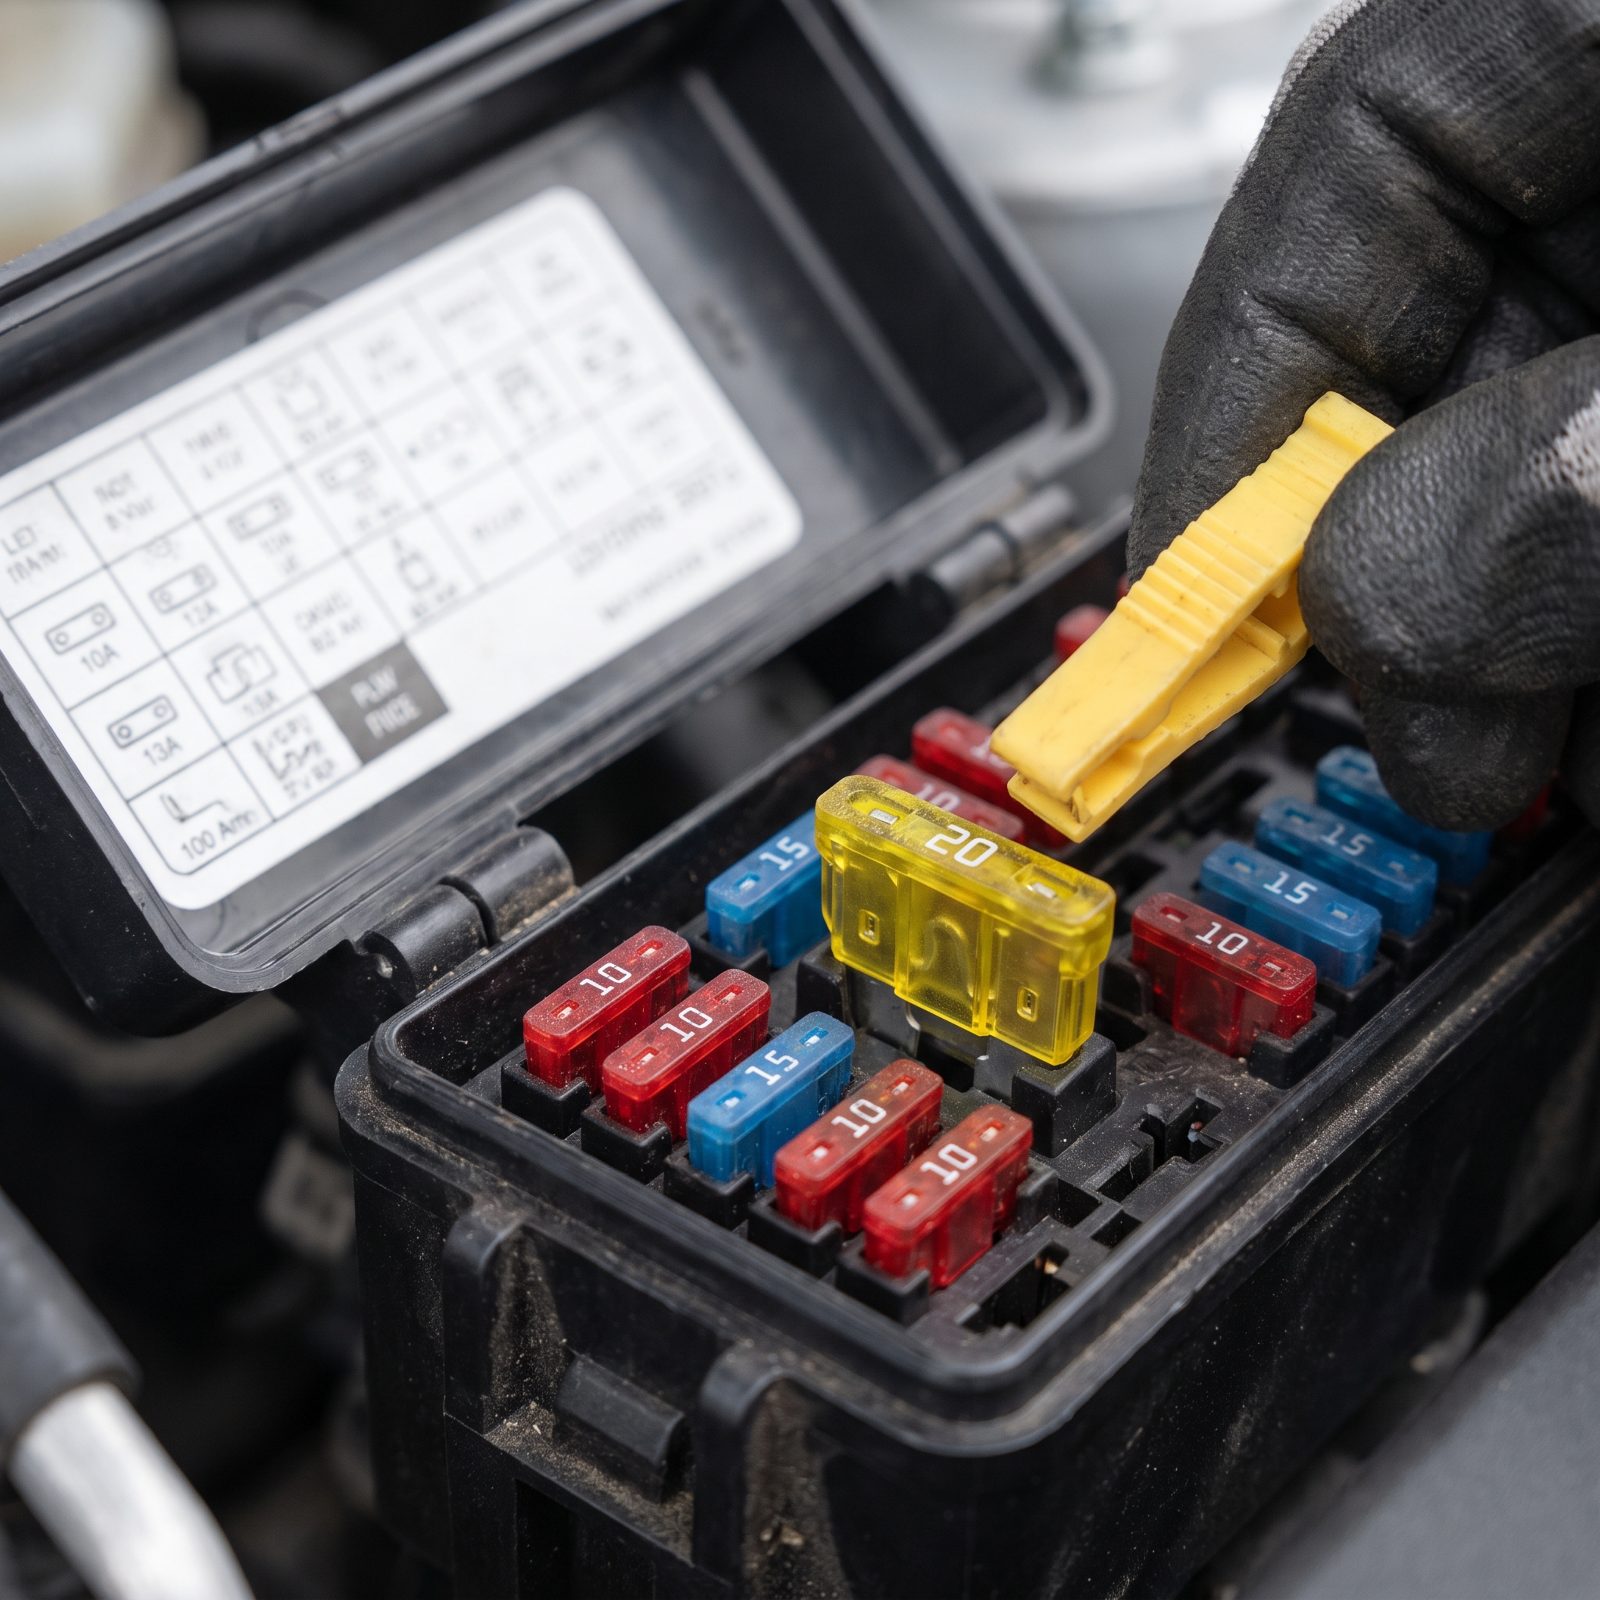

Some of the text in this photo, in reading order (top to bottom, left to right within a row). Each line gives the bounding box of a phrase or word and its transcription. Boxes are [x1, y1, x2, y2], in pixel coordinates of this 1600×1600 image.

[81, 642, 120, 674] 10A
[144, 736, 182, 766] 13A
[181, 829, 216, 860] 100
[760, 836, 810, 871] 15
[925, 823, 998, 867] 20
[1319, 823, 1376, 856] 15
[1263, 870, 1318, 904] 15
[1195, 921, 1249, 955] 10
[580, 962, 632, 997] 10
[660, 1006, 713, 1043] 10
[745, 1049, 799, 1086] 15
[831, 1099, 888, 1139] 10
[920, 1143, 978, 1186] 10
